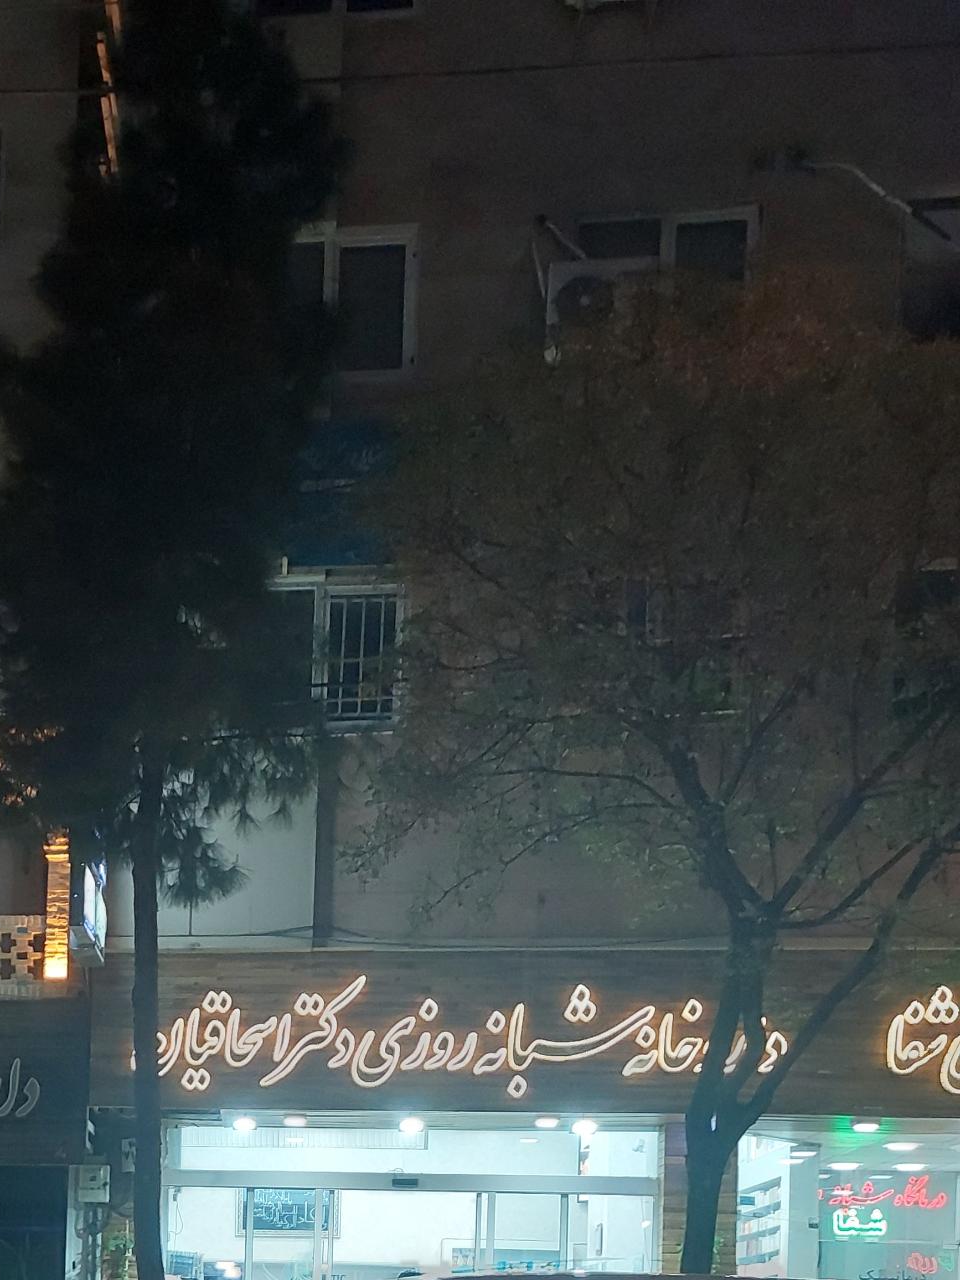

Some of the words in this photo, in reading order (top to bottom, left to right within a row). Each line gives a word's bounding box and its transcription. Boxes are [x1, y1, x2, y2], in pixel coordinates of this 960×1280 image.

[259, 974, 367, 1087] دکتر
[351, 998, 479, 1088] روزی
[473, 983, 656, 1098] شبانه
[622, 998, 788, 1076] درخانه
[832, 1208, 889, 1237] شفا
